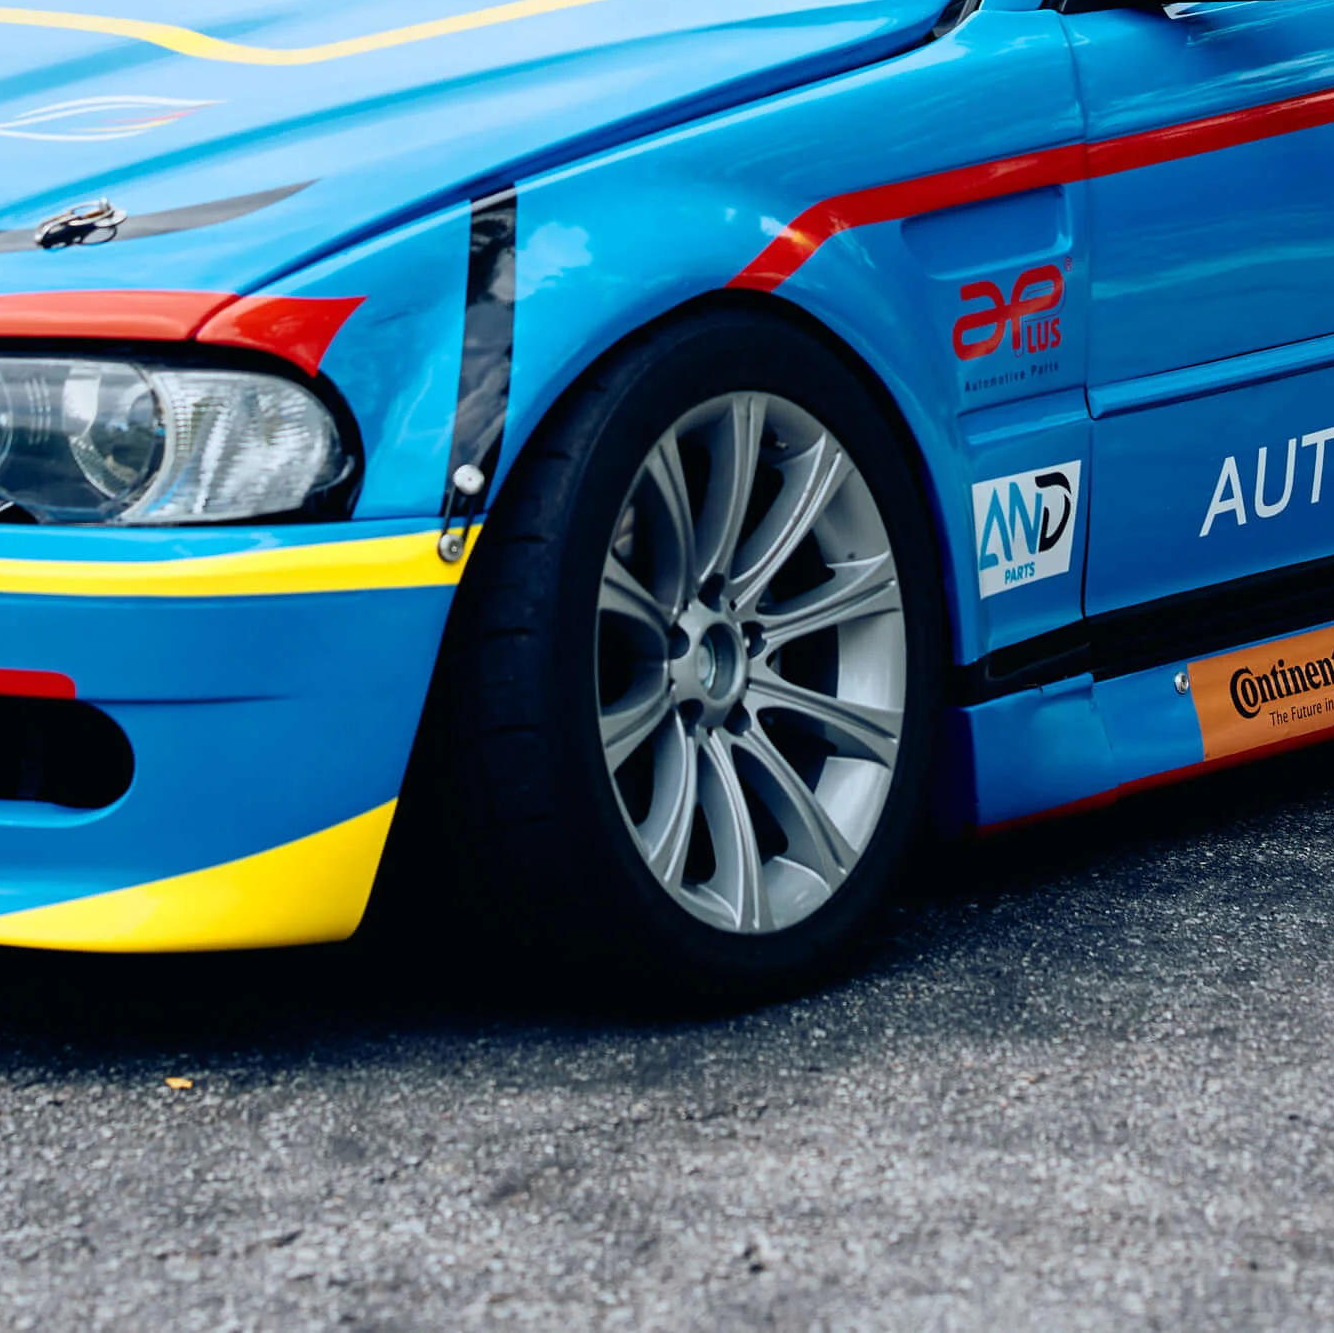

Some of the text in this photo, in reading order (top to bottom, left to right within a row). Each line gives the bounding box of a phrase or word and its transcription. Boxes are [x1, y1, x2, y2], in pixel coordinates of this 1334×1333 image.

[964, 361, 1059, 393] Automotive Parts
[979, 471, 1072, 571] AND
[1004, 562, 1036, 584] PARTS
[1269, 711, 1289, 726] The
[1291, 703, 1322, 720] Future
[1325, 699, 1334, 712] in
